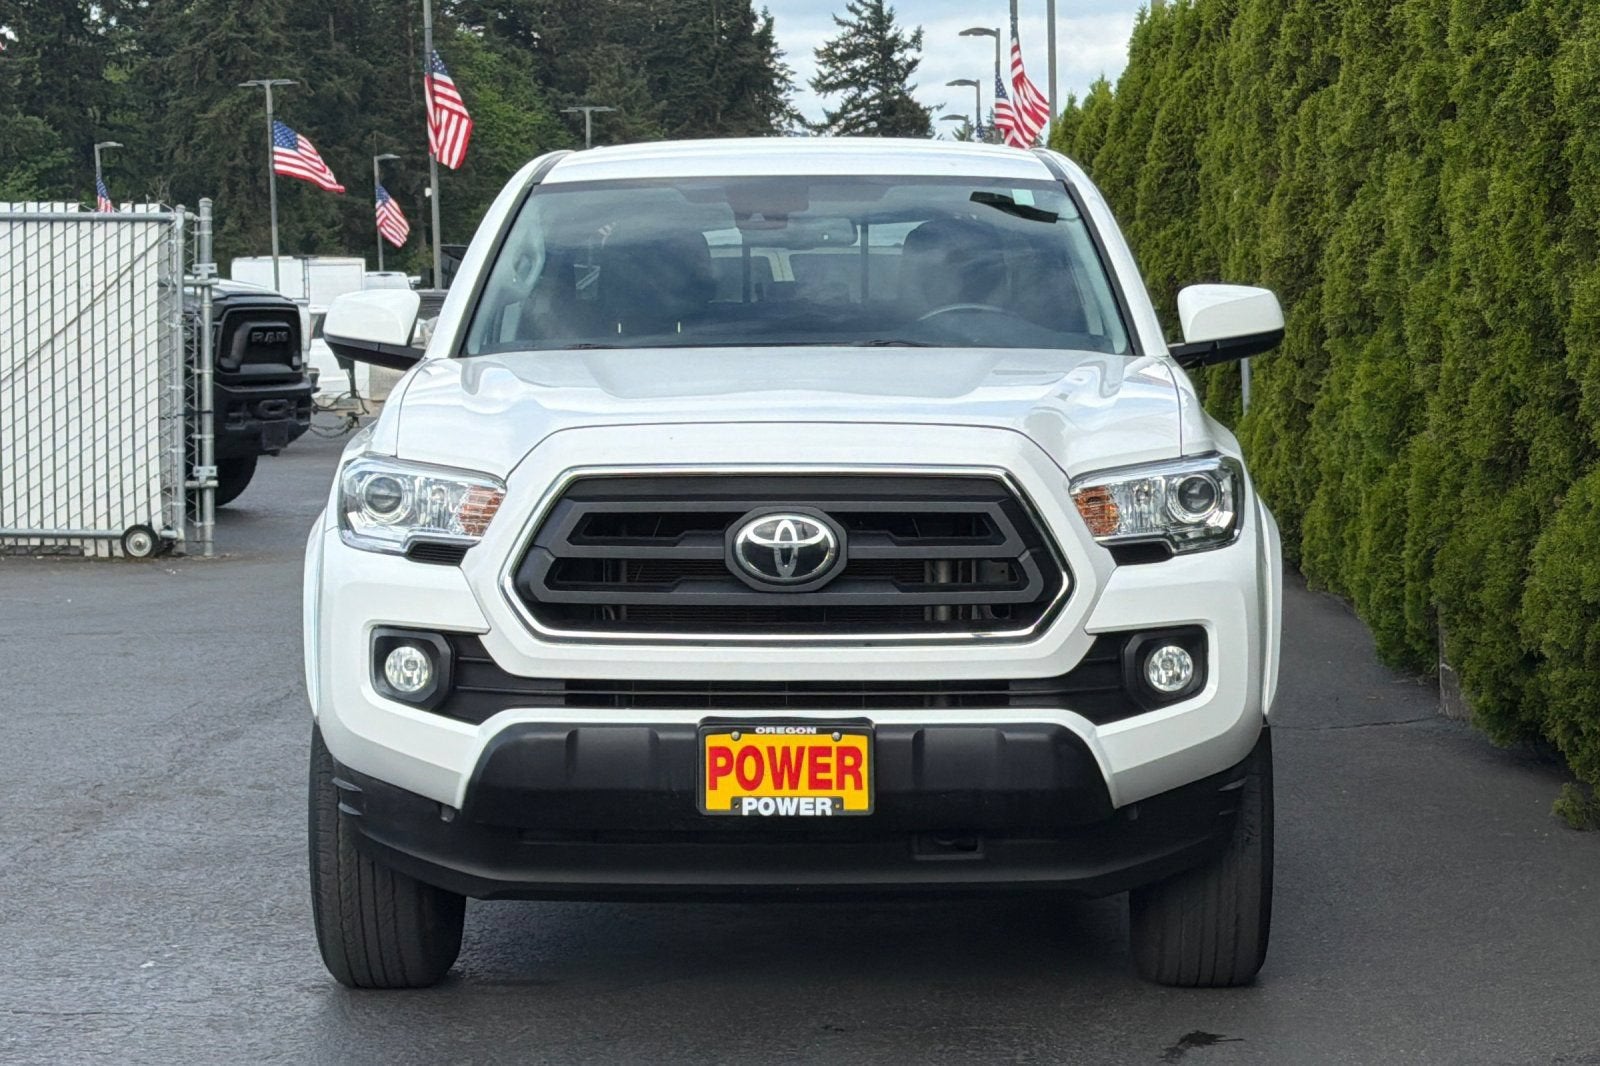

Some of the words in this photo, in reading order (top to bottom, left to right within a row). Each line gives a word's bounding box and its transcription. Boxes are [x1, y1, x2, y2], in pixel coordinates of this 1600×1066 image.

[755, 726, 817, 734] OREGON
[708, 745, 863, 791] POWER
[742, 797, 832, 816] POWER
